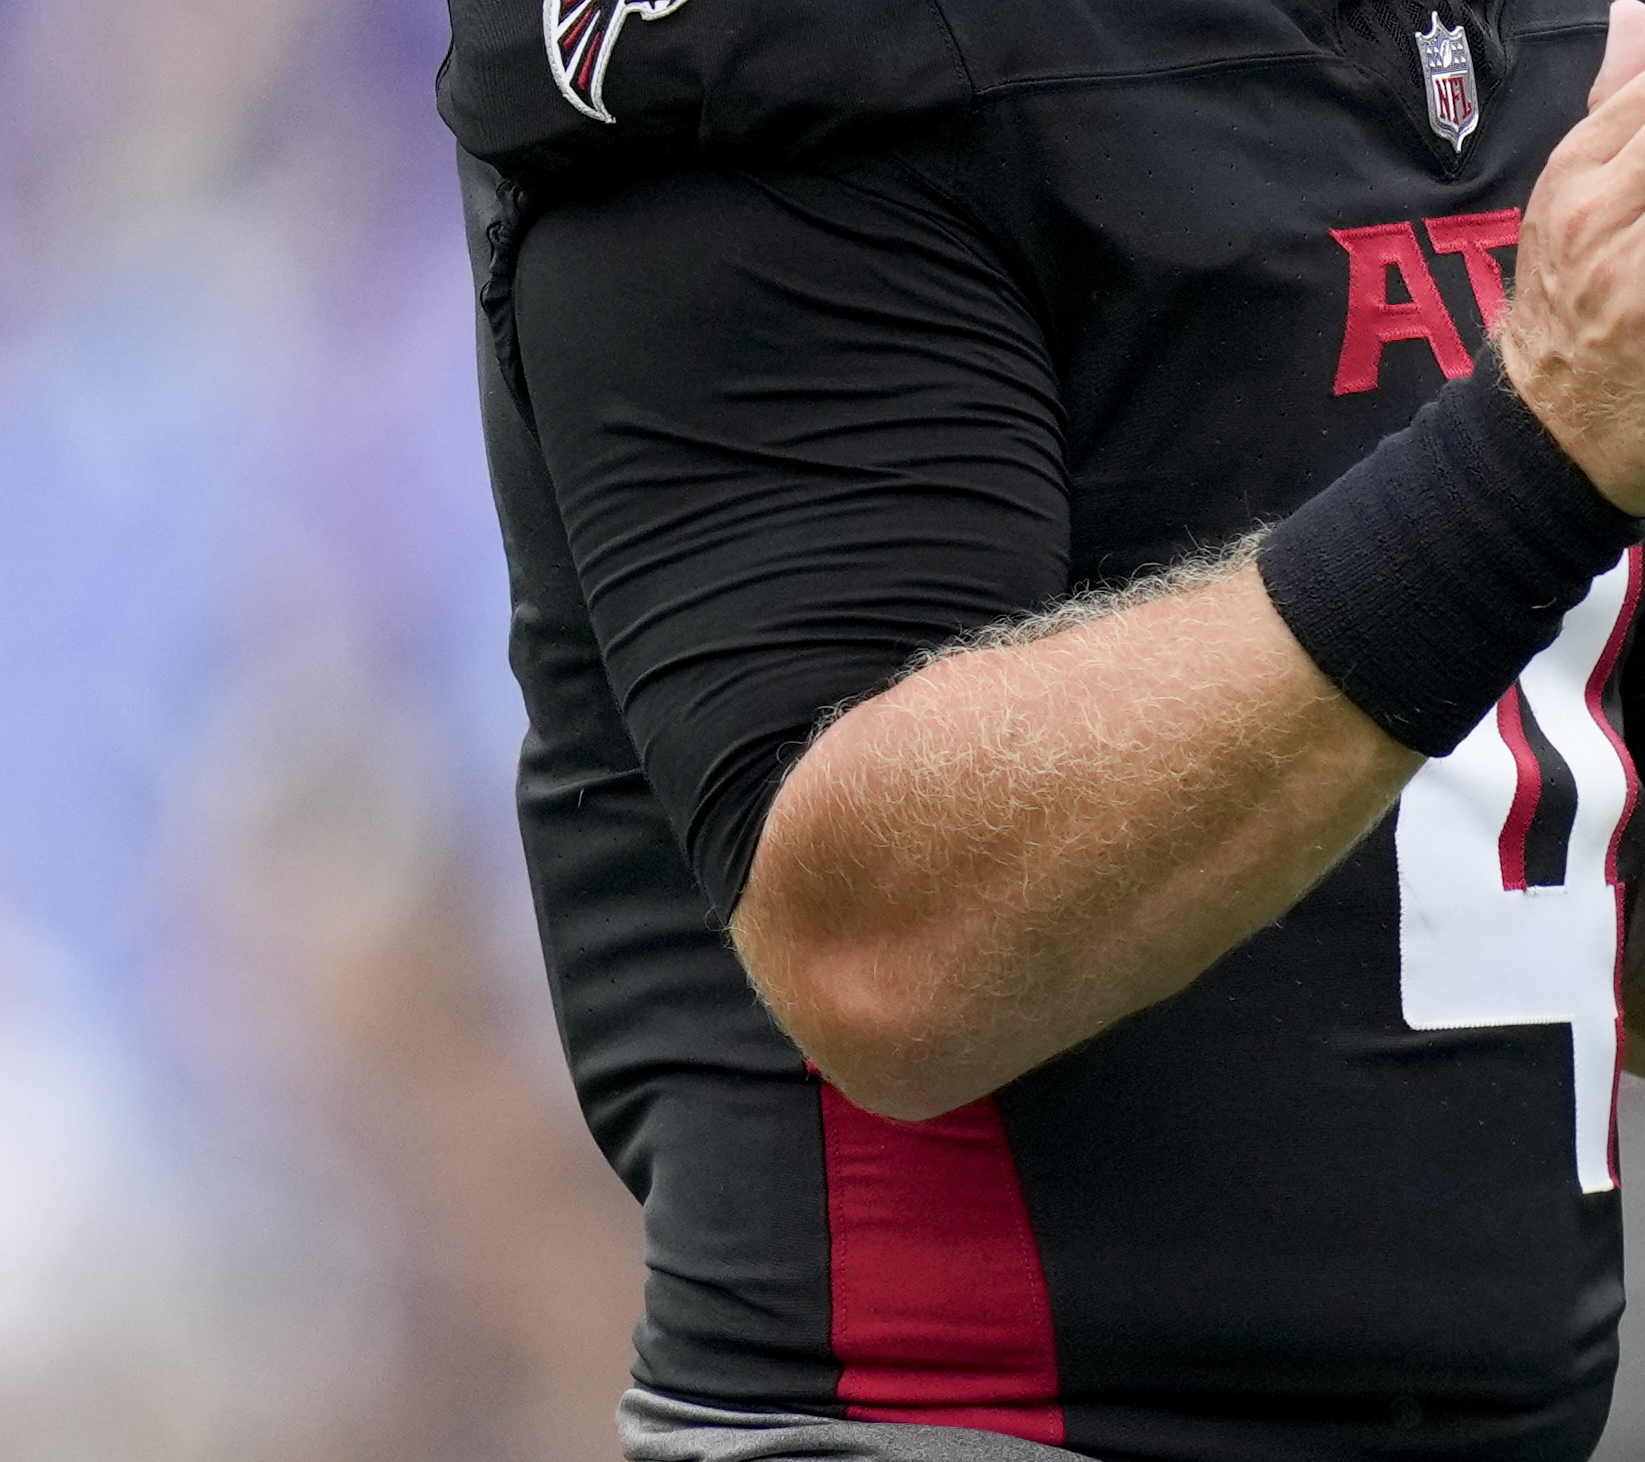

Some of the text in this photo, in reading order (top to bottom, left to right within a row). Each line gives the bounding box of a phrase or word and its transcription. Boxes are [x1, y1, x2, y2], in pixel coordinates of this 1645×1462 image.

[1434, 76, 1472, 126] NFL
[1327, 207, 1522, 397] AT
[1396, 541, 1628, 1195] 4
